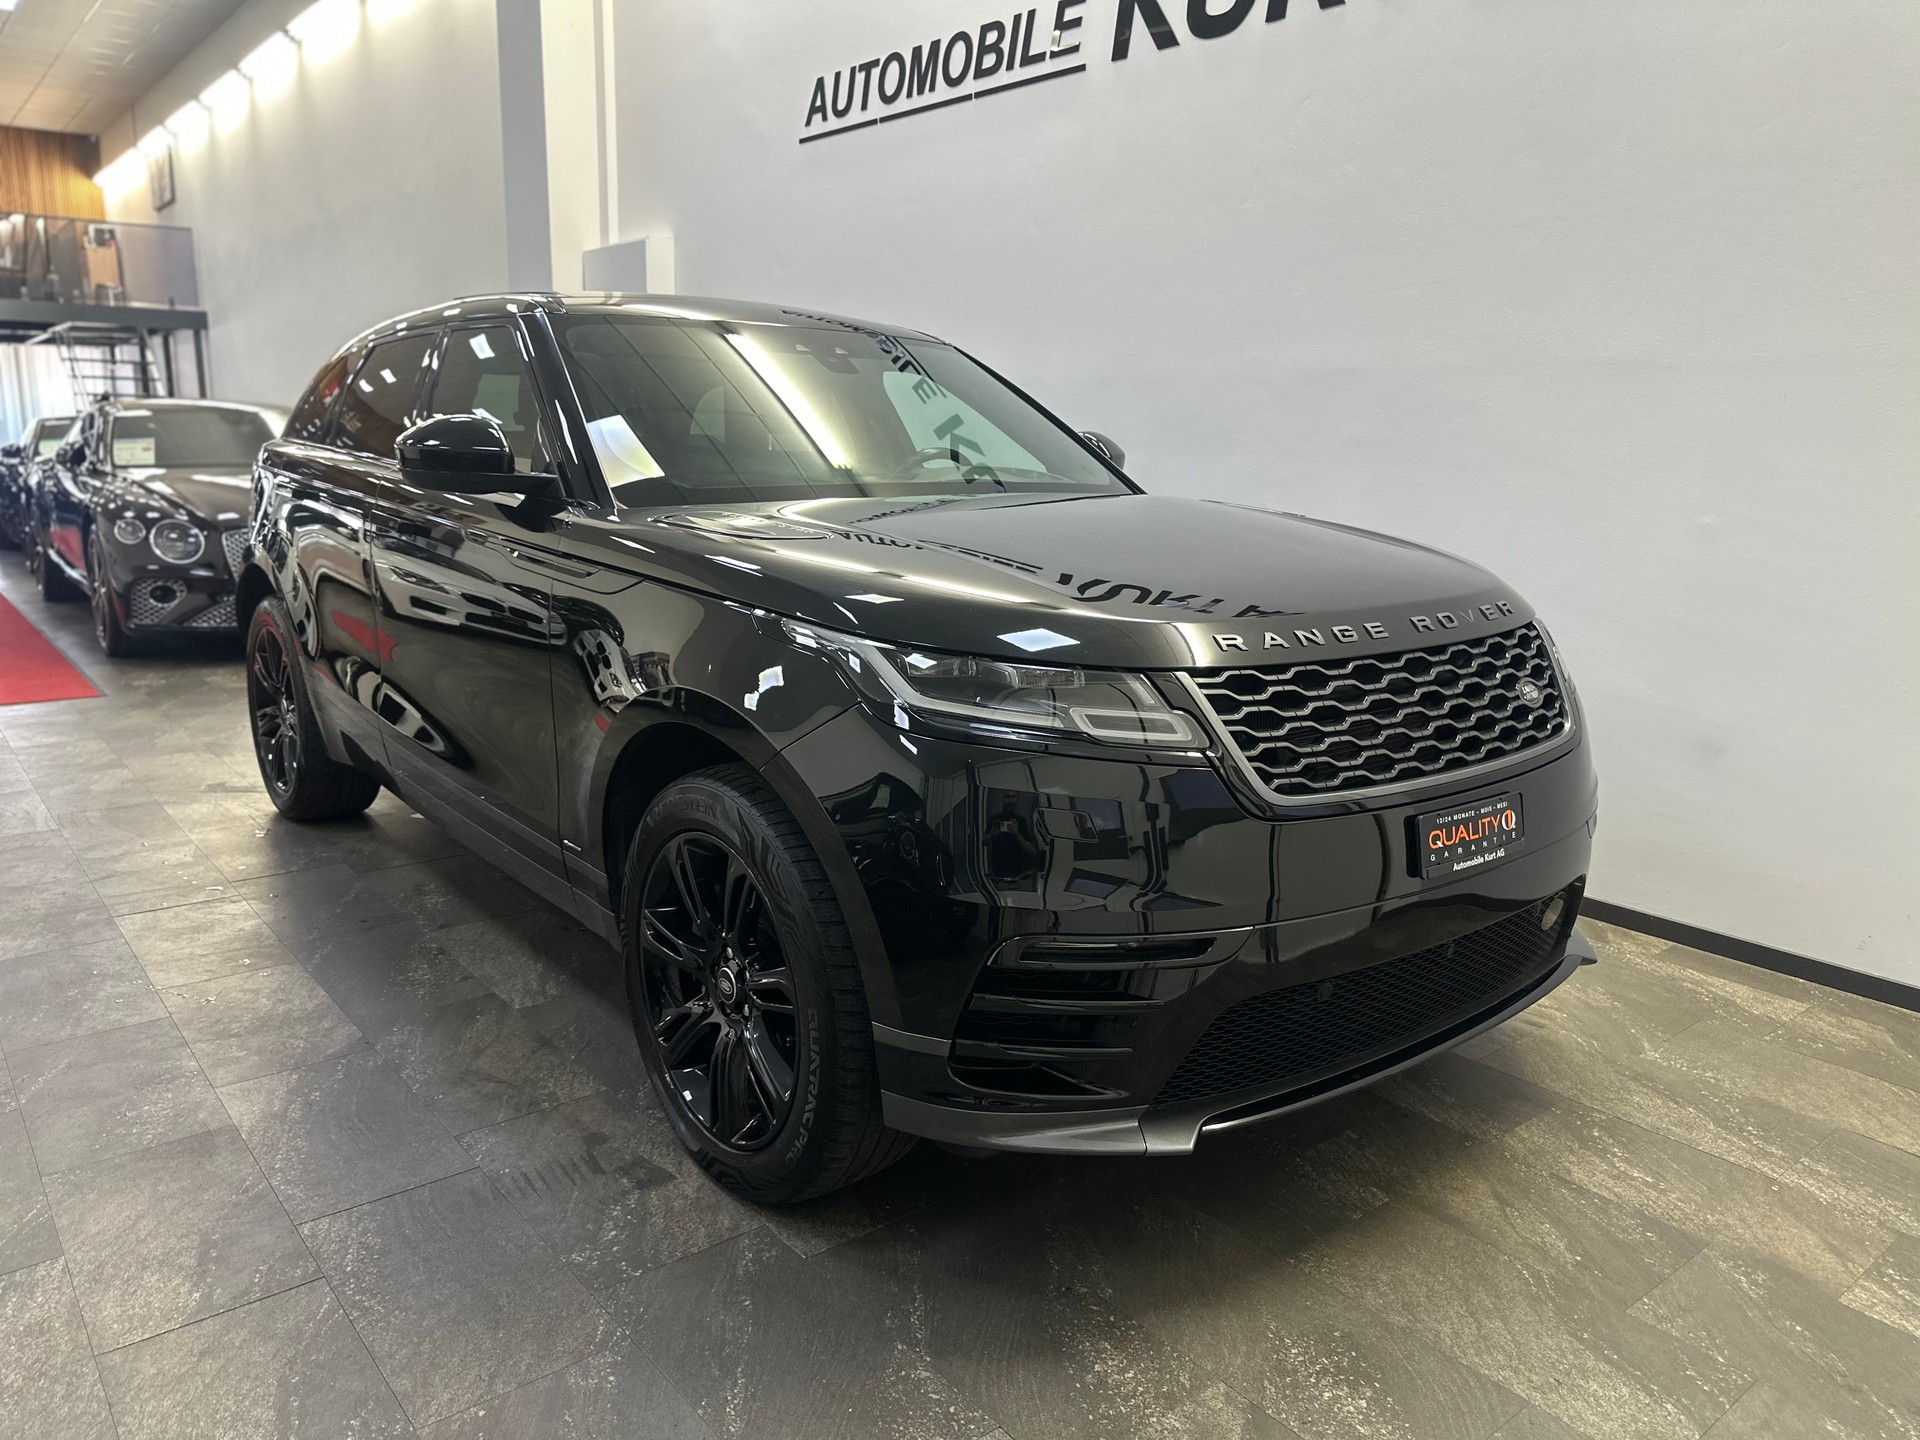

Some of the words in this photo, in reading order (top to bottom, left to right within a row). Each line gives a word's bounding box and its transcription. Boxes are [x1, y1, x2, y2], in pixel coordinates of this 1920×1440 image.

[804, 0, 1086, 127] AUTOMOBILE
[1212, 621, 1390, 652] RANGE
[1410, 600, 1516, 634] ROVER
[1436, 815, 1452, 824] 12/24
[1453, 810, 1475, 821] MONATE
[1430, 831, 1516, 862] GARANTIE
[1453, 854, 1484, 871] Automobile
[1484, 851, 1497, 862] Kurt
[1496, 848, 1505, 857] AG
[801, 1007, 821, 1129] QUATRAC
